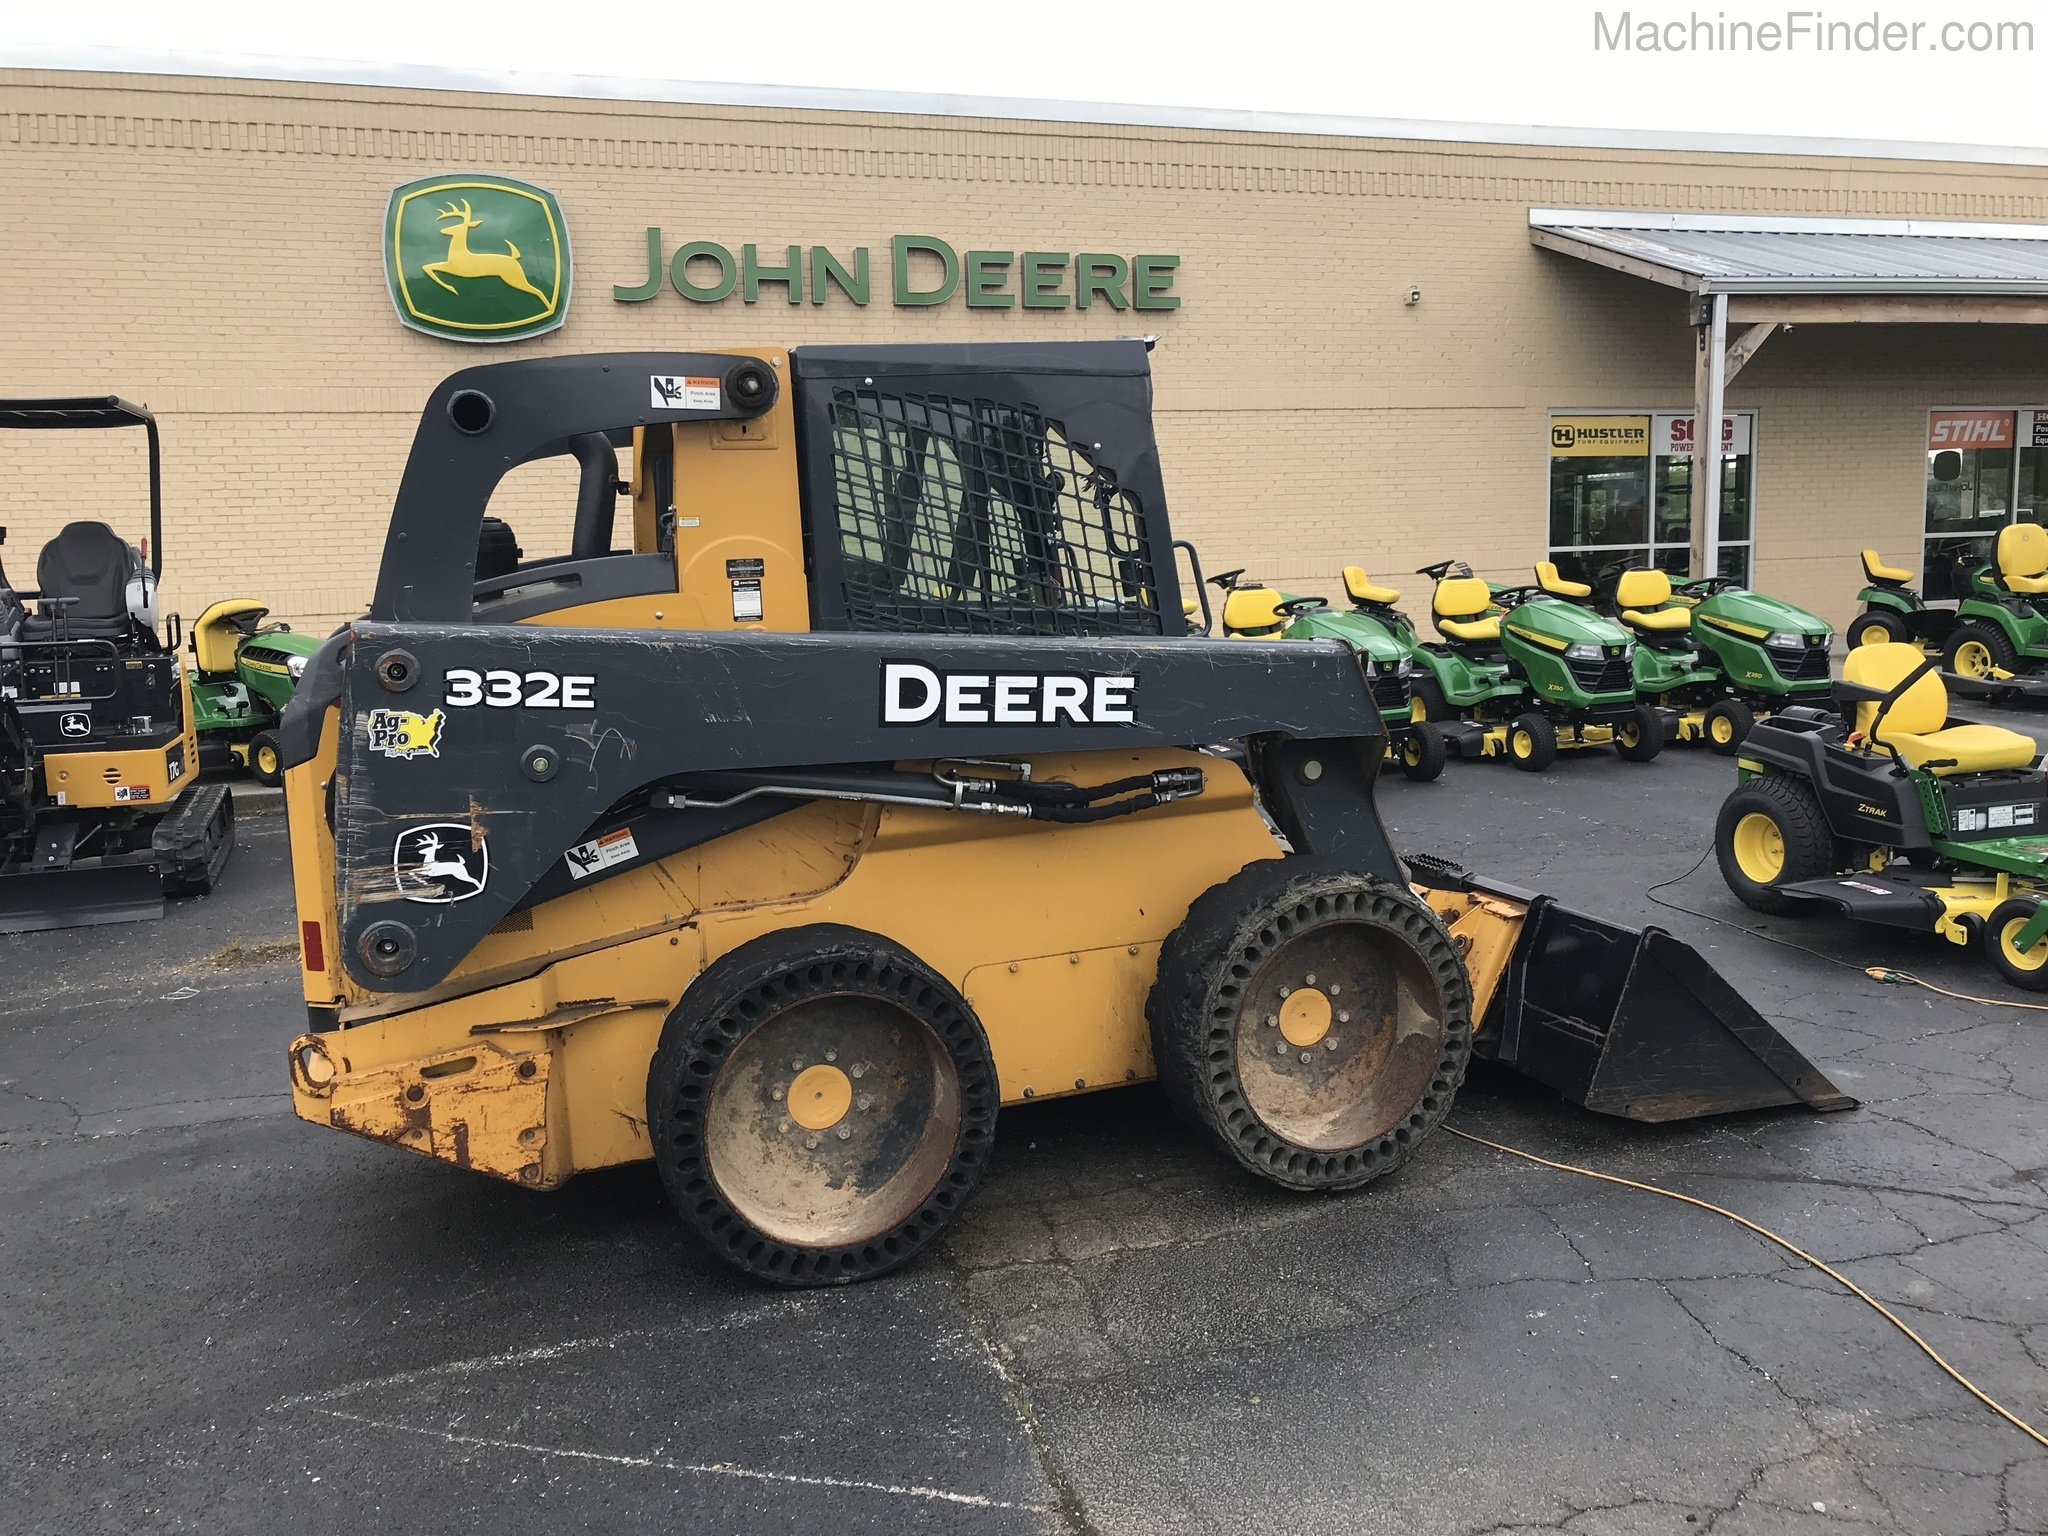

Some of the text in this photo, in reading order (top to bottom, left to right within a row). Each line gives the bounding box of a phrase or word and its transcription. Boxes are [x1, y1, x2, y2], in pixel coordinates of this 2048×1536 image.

[613, 227, 1181, 310] JOHN DEERE
[1577, 428, 1645, 438] HUSTLER
[1745, 671, 1763, 679] X350
[445, 669, 595, 708] 332E
[884, 664, 1135, 723] DEERE
[372, 712, 408, 732] Ag-
[373, 731, 409, 747] Pro
[169, 761, 179, 780] 17G
[1857, 803, 1887, 818] ZTRAK
[605, 831, 628, 842] WARNING
[620, 841, 630, 849] Area
